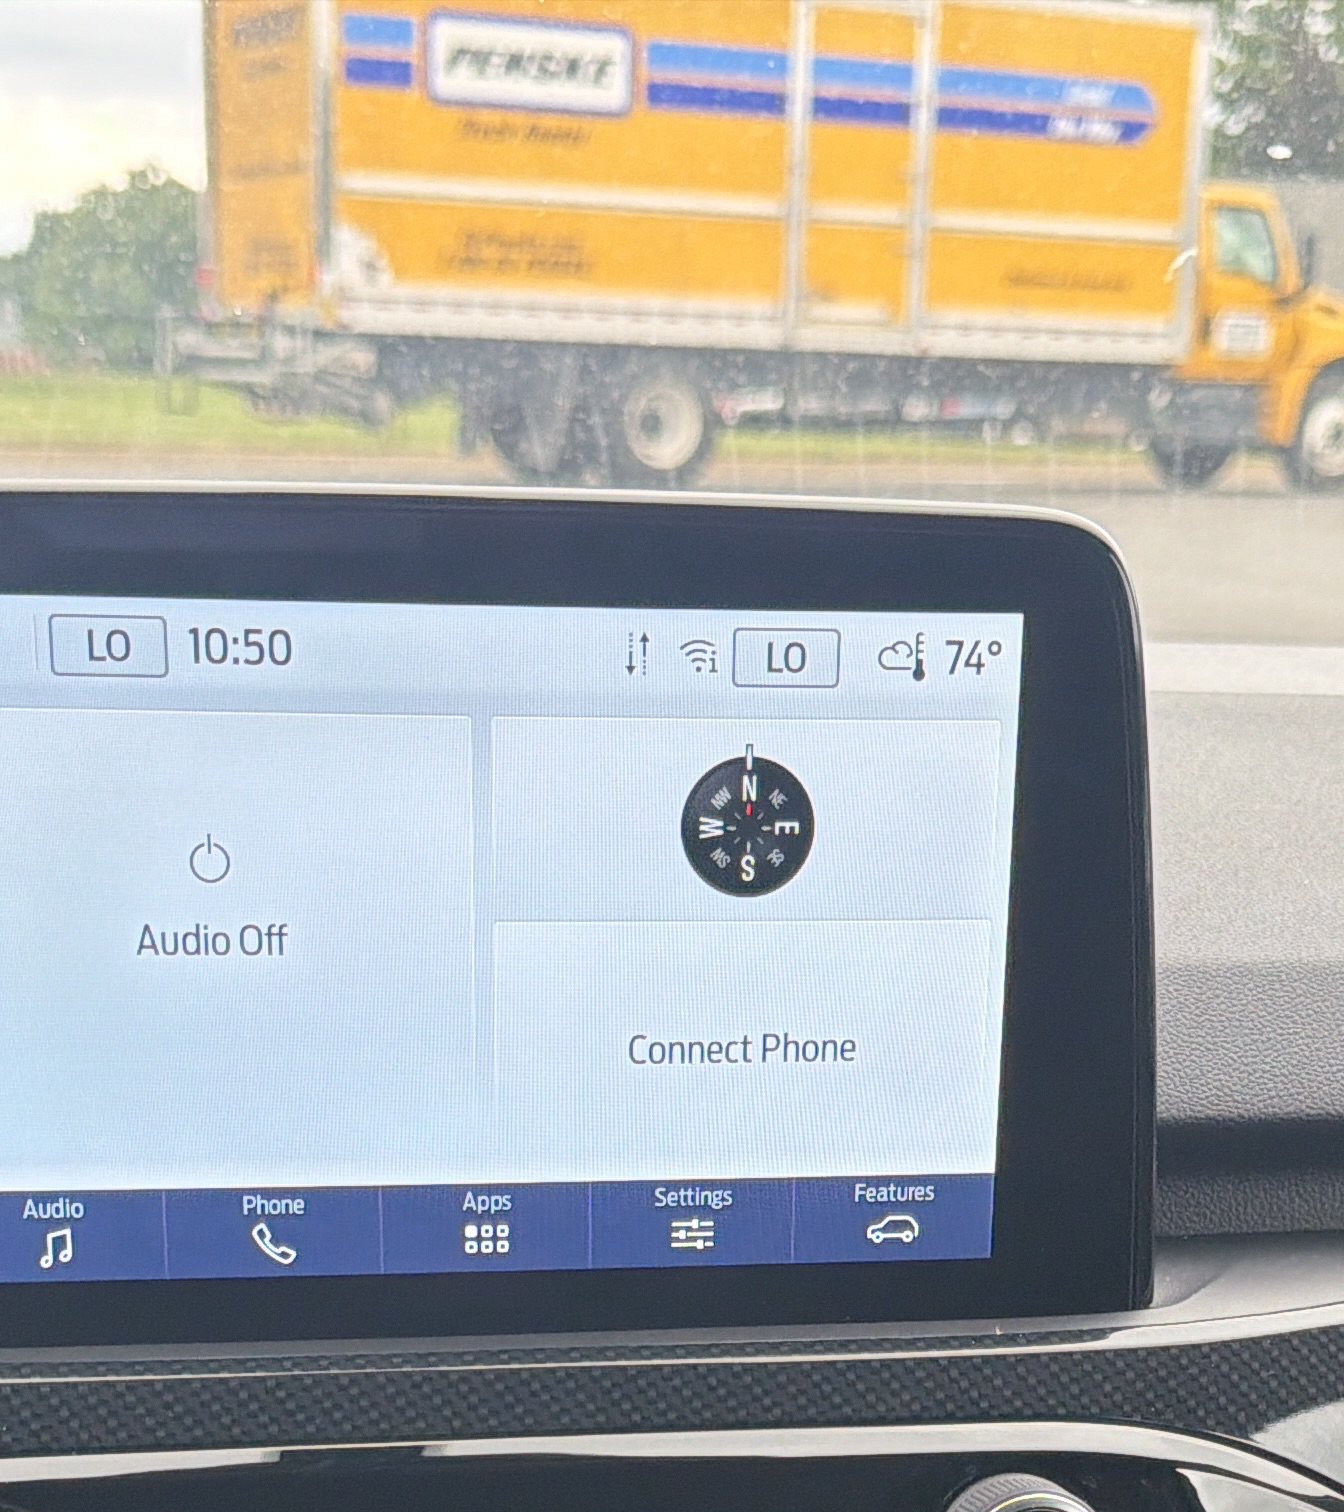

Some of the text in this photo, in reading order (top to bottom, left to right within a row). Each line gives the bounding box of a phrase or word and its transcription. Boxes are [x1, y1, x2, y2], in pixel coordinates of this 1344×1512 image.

[443, 45, 618, 92] PENSKE
[87, 627, 293, 666] LO 10:50
[766, 639, 1003, 676] LO 74°
[741, 774, 758, 802] N
[698, 816, 725, 840] W
[774, 821, 800, 836] E
[740, 854, 756, 882] S
[136, 923, 289, 956] Audio Off
[628, 1032, 857, 1065] Connect Phone
[242, 1195, 305, 1216] Phone
[462, 1191, 512, 1214] Apps
[654, 1187, 734, 1210] Settings
[854, 1183, 935, 1204] Features
[23, 1198, 85, 1220] Audio
